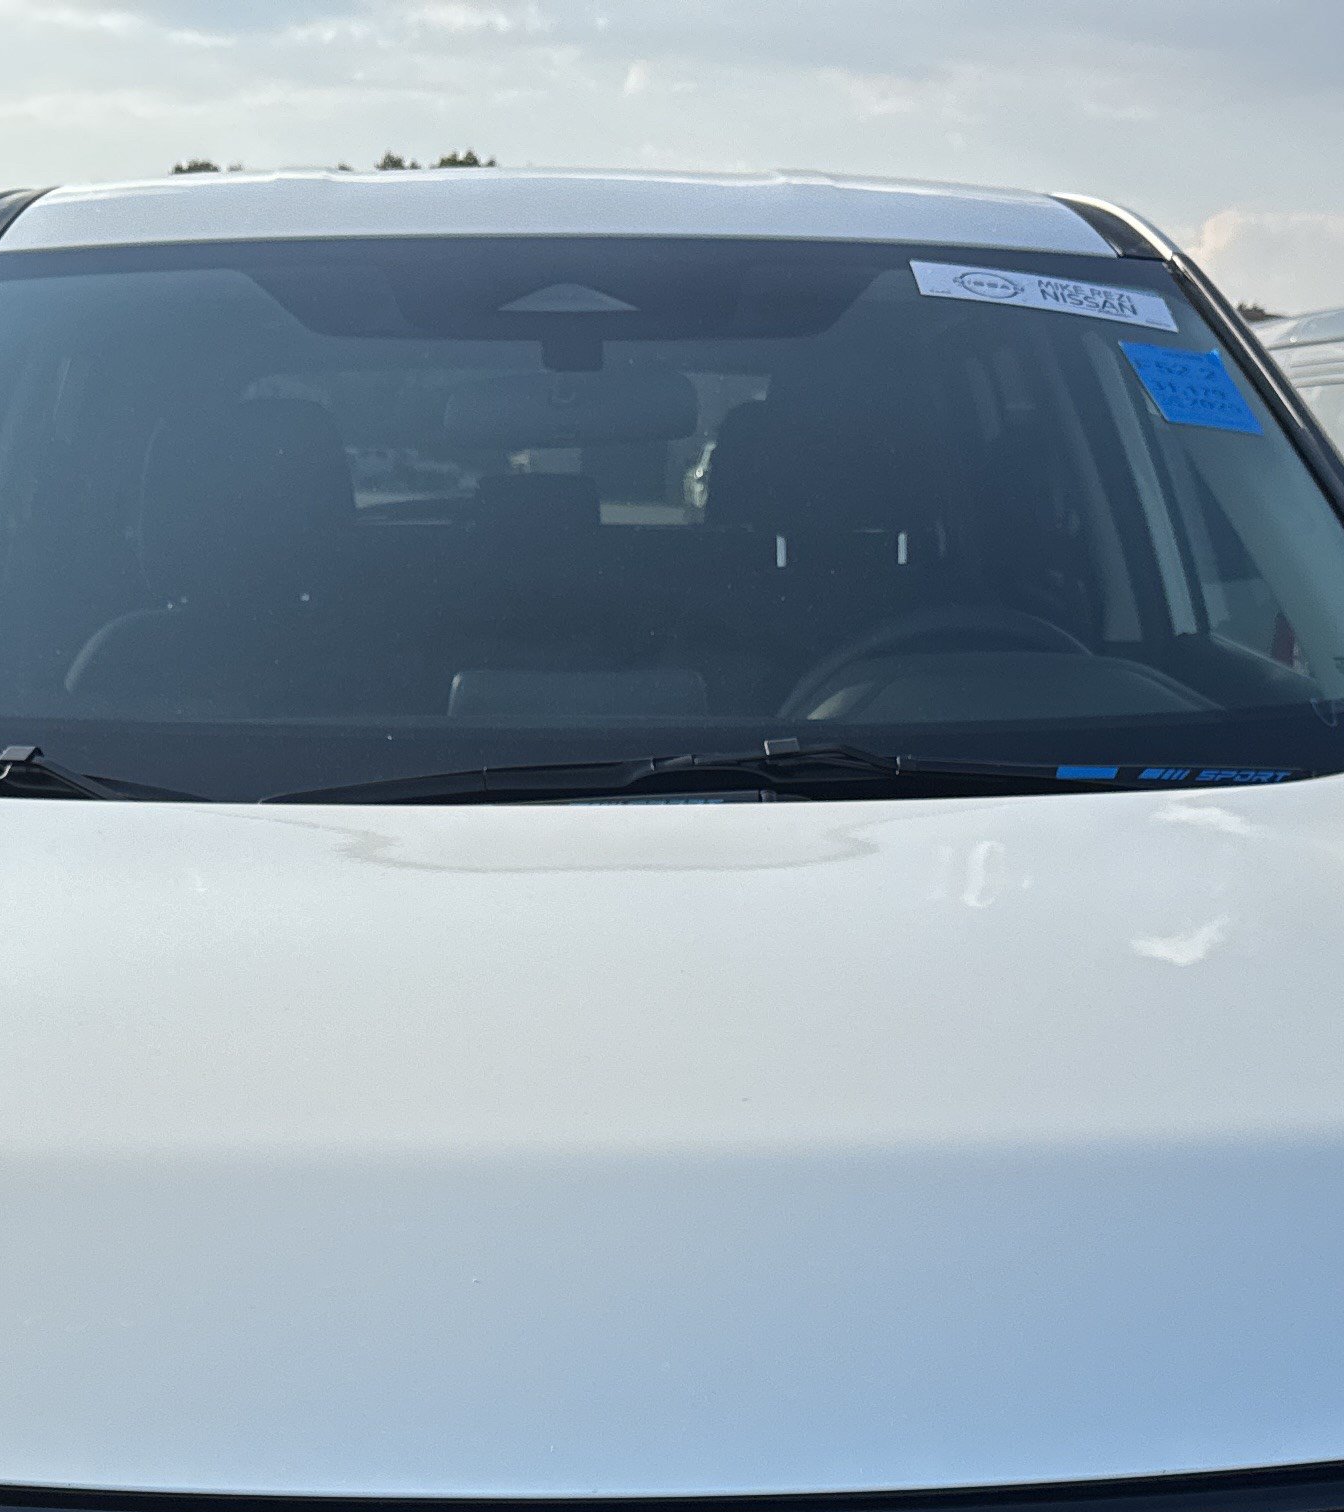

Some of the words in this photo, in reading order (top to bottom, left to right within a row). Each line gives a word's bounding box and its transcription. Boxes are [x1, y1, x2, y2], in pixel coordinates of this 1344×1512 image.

[1037, 279, 1088, 296] MIKE
[1040, 289, 1138, 316] NISSAN
[1195, 769, 1292, 783] SPORT
